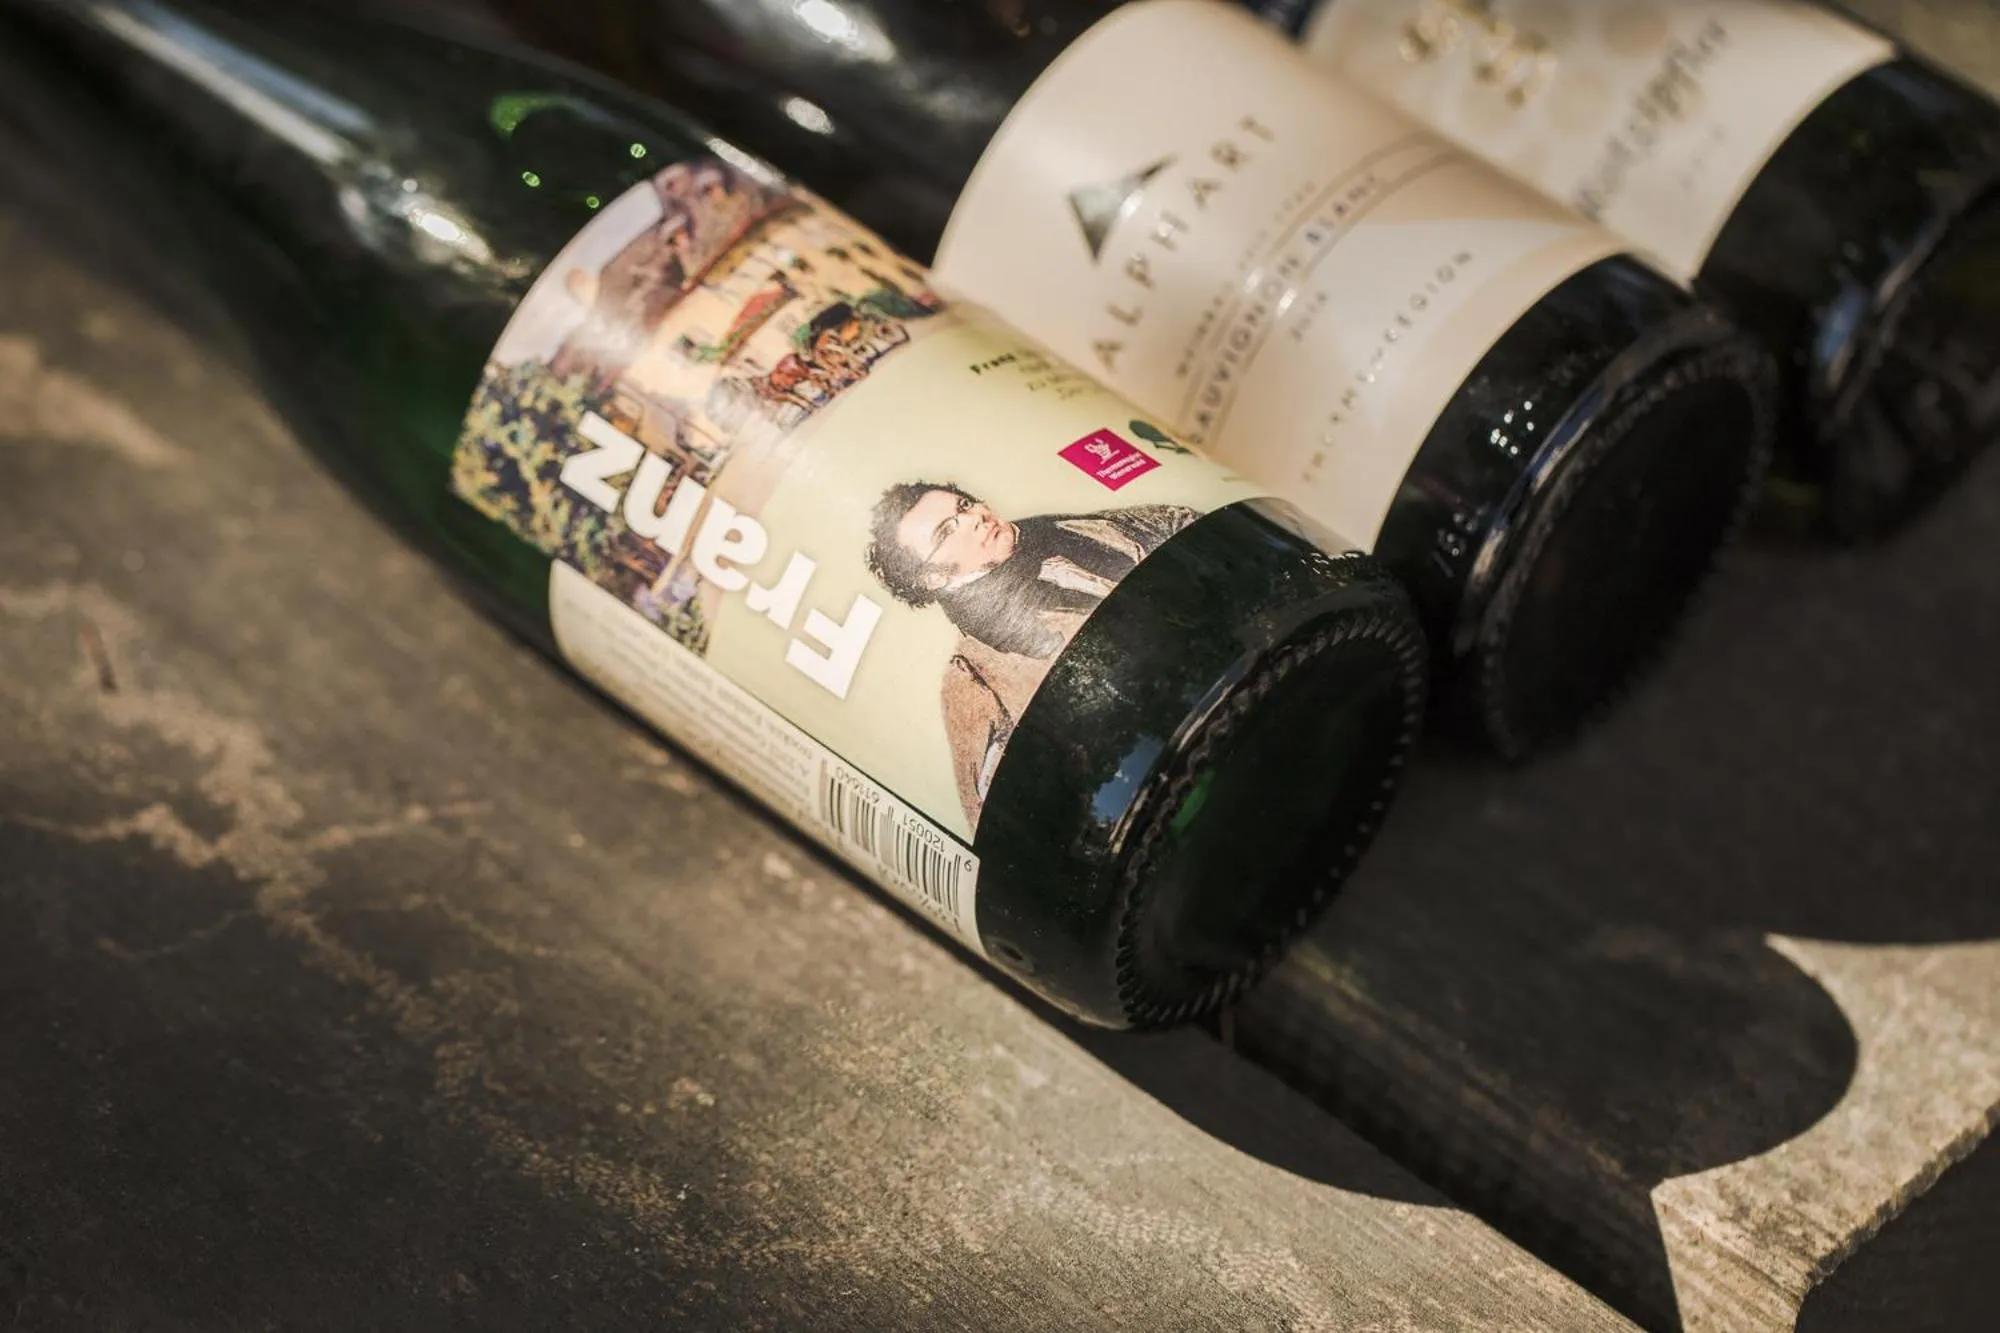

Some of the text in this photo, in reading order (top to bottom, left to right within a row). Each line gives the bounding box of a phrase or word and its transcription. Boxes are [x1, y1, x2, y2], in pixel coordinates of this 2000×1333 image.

[1091, 113, 1276, 374] ALPHART
[1187, 255, 1302, 446] SAUVIGNON
[559, 410, 884, 700] Franz
[903, 813, 945, 853] 120051
[963, 859, 973, 873] 9
